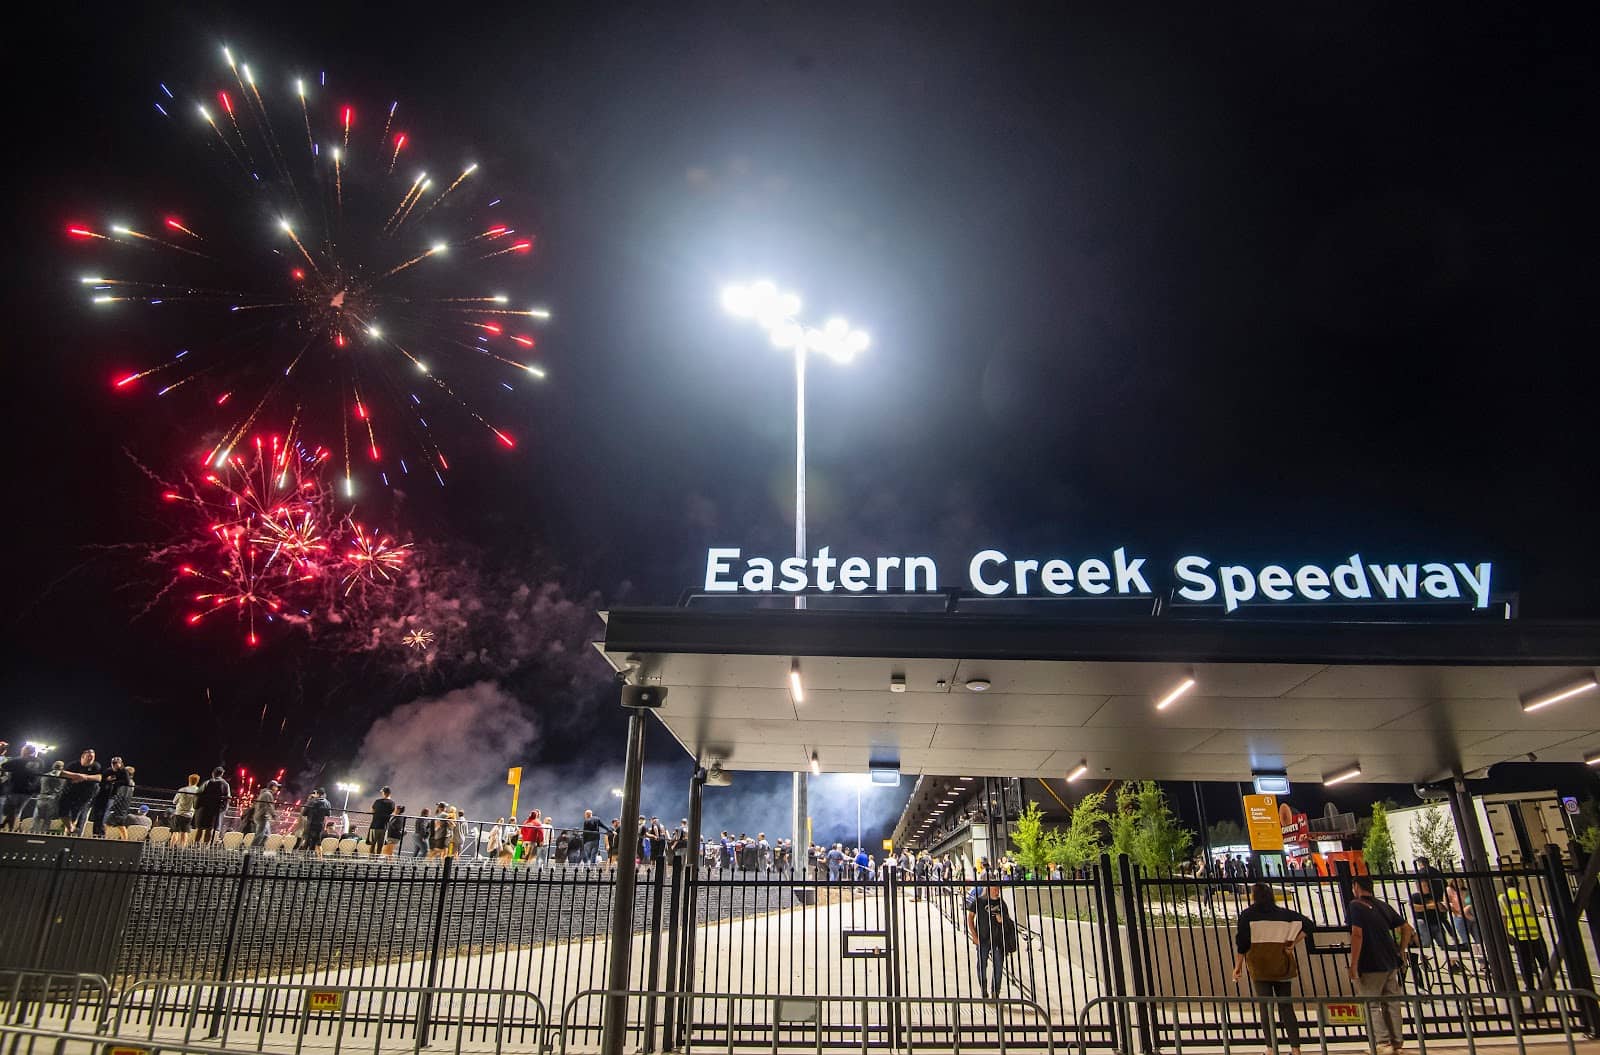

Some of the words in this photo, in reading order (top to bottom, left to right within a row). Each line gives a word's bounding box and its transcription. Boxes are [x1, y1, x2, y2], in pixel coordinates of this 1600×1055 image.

[704, 547, 937, 592] Eastern
[969, 547, 1152, 595] Creek
[1176, 554, 1492, 612] Speedway
